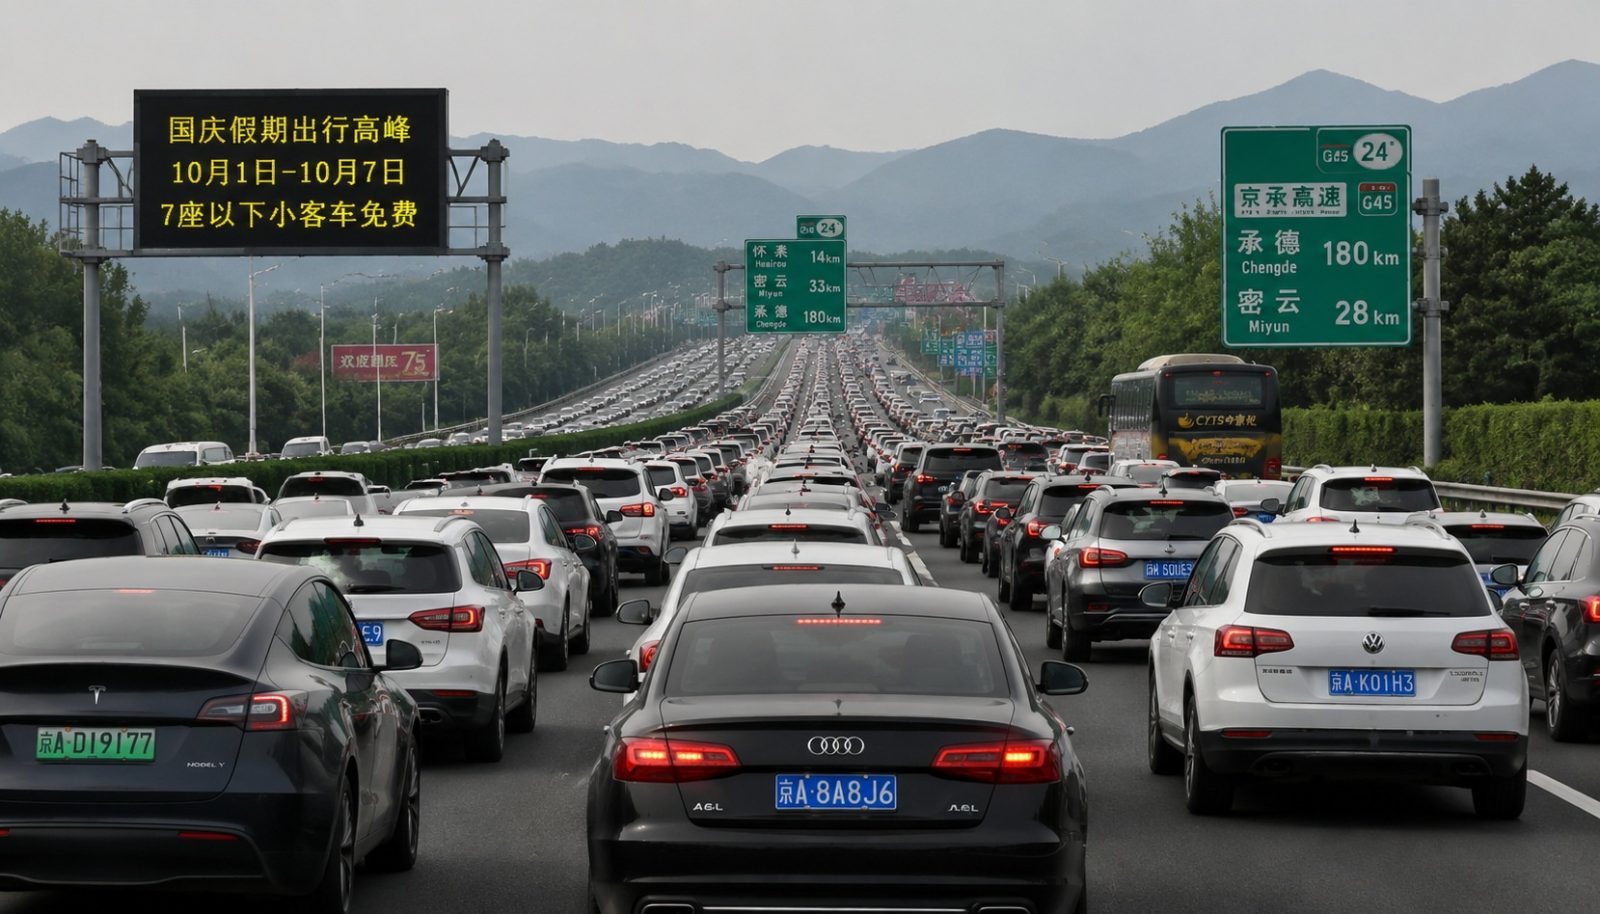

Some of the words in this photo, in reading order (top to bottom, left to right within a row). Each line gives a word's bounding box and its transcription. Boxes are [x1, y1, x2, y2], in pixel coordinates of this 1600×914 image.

[168, 115, 411, 144] 国庆假期出行高峰
[172, 158, 405, 186] 10月1日-10月7日
[1240, 185, 1341, 208] 京承高速
[1362, 194, 1392, 210] G45
[161, 200, 417, 228] 7座以下小客车免费
[1237, 229, 1300, 256] 承德
[1323, 241, 1369, 266] 180
[1373, 251, 1400, 266] km
[1242, 260, 1297, 277] Chengde
[1237, 288, 1301, 315] 密云
[1335, 300, 1369, 326] 28
[1373, 310, 1400, 326] km
[1249, 320, 1290, 336] Miyun
